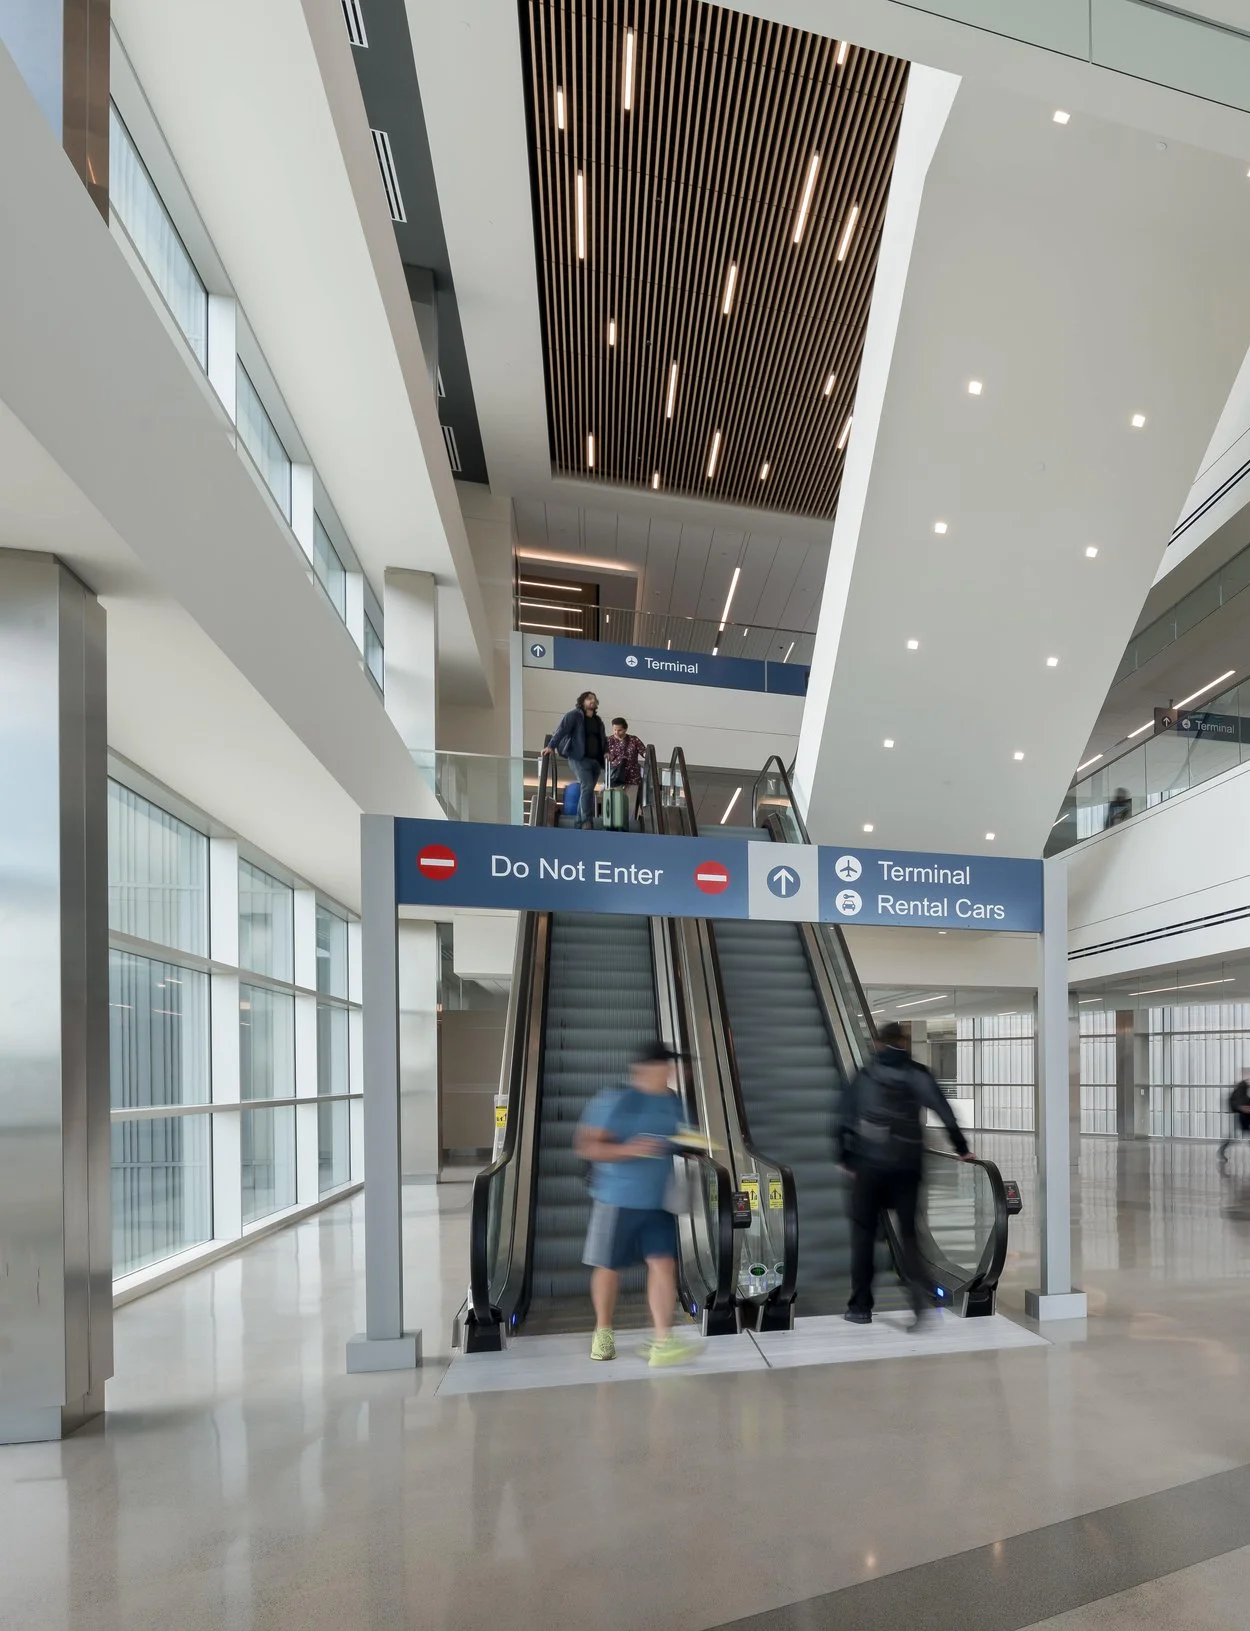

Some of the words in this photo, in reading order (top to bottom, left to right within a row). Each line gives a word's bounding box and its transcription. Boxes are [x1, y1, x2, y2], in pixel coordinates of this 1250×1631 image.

[644, 657, 699, 674] Terminal
[1195, 720, 1235, 734] Terminal
[491, 855, 530, 878] Do
[539, 857, 586, 882] Not
[594, 861, 664, 885] Enter
[878, 860, 971, 885] Terminal
[878, 894, 948, 917] Rental
[955, 898, 1005, 919] Cars
